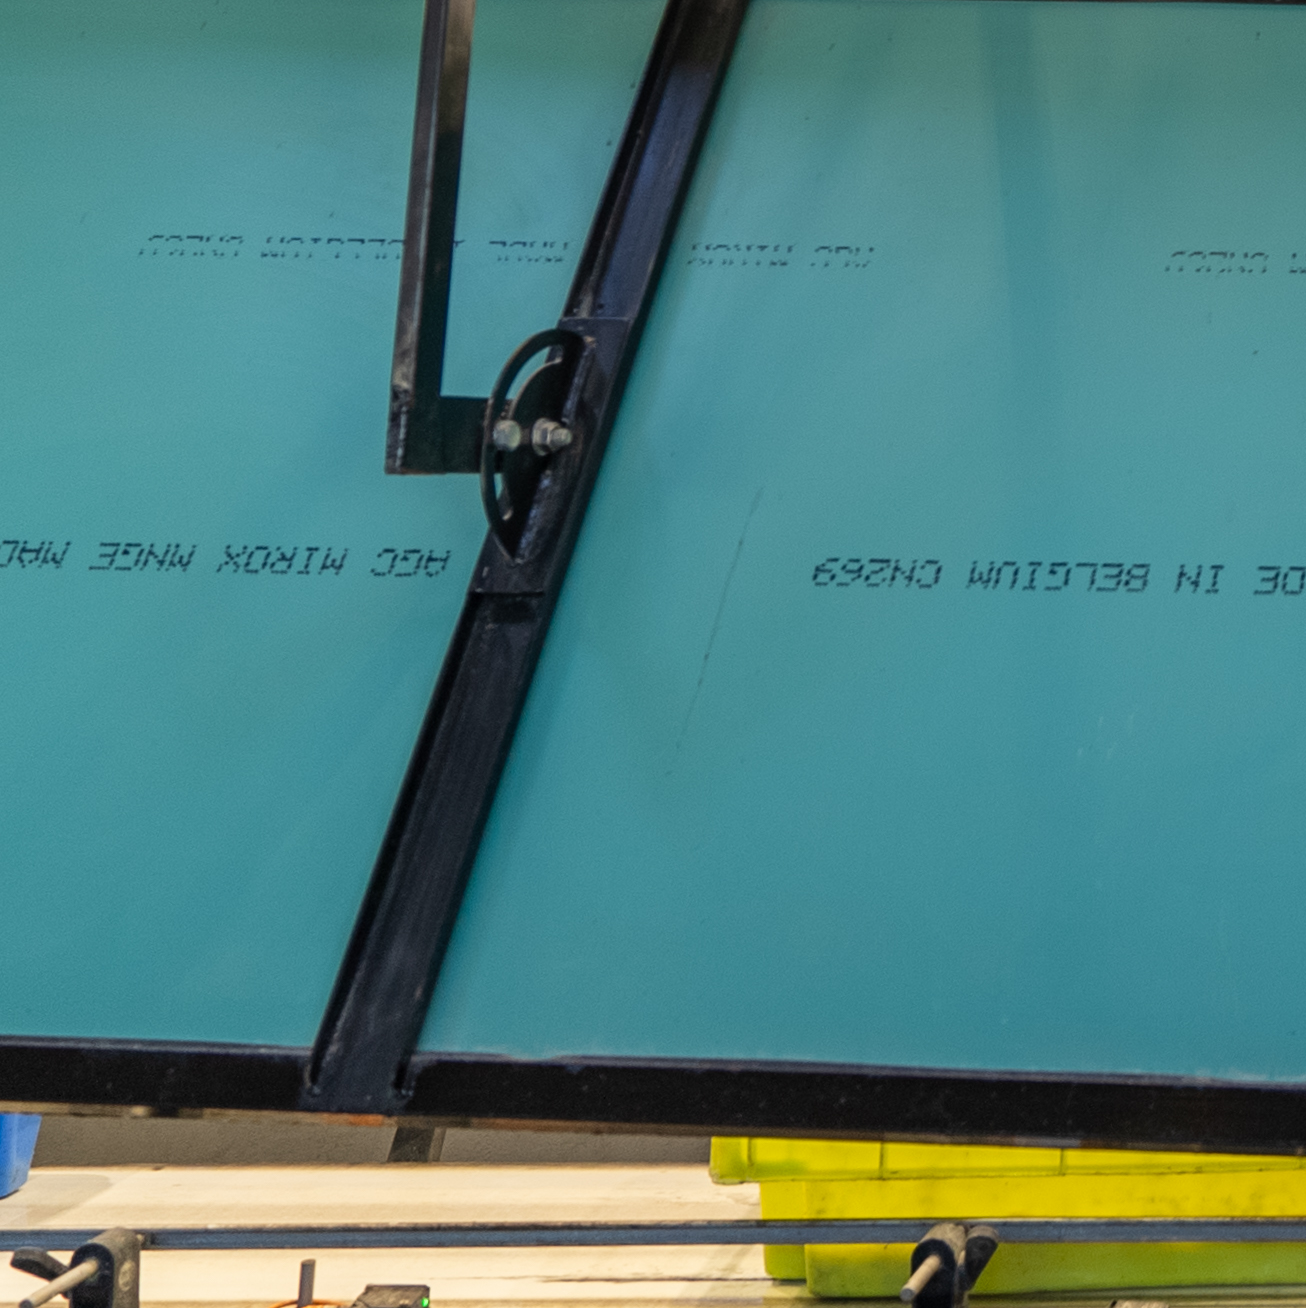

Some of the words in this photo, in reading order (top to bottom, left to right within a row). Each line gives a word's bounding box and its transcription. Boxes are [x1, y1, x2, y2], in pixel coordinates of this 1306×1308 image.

[89, 541, 198, 573] MNGE
[216, 544, 349, 576] MIROX
[370, 547, 452, 579] AGC
[811, 556, 943, 590] CN269
[966, 560, 1151, 593] BELGIUM
[1174, 563, 1225, 595] IN
